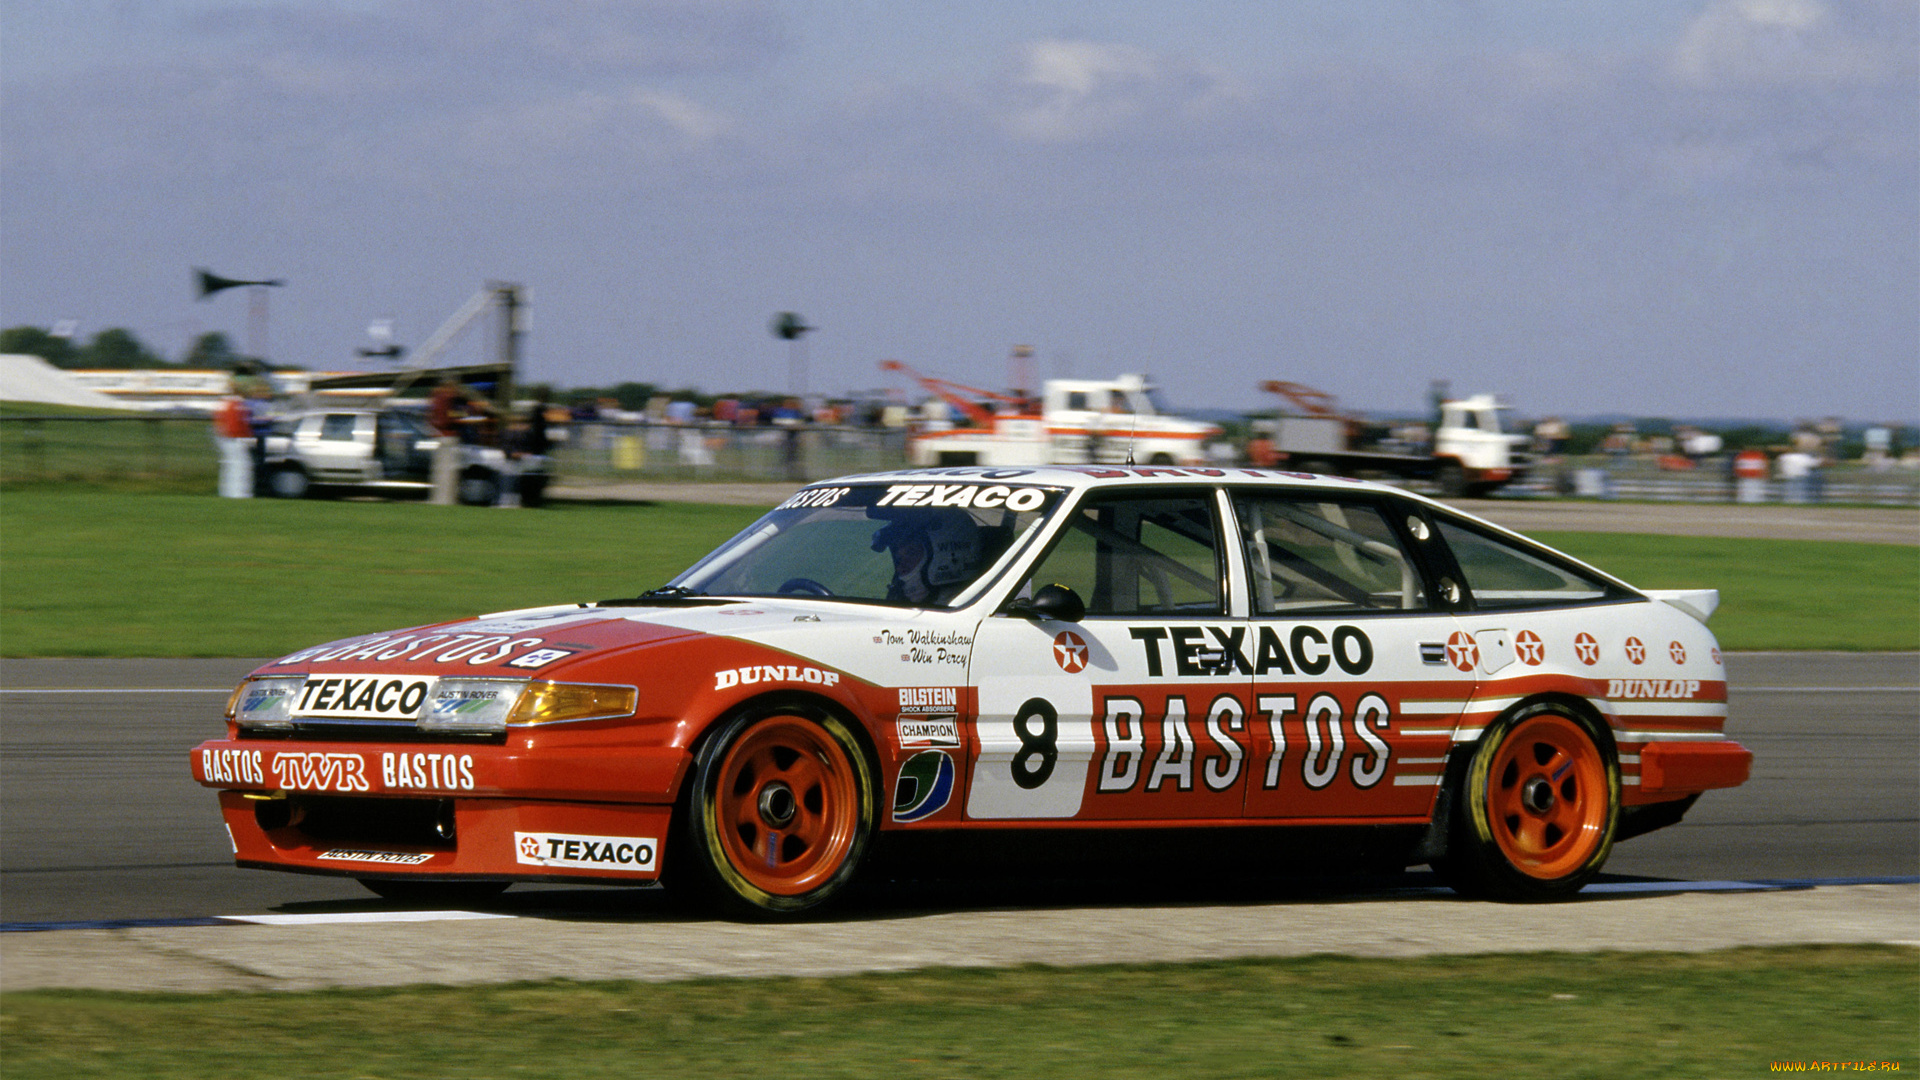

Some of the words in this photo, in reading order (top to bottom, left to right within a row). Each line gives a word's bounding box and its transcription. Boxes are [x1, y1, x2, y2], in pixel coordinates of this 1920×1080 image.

[876, 484, 1046, 512] TEXACO
[312, 633, 544, 665] BASTOS
[881, 629, 905, 645] Tom
[907, 629, 973, 645] Walkinshaw
[910, 647, 933, 663] Win
[937, 647, 967, 668] Percy
[1129, 625, 1374, 677] TEXACO
[714, 665, 840, 691] DUNLOP
[1606, 679, 1700, 698] DUNLOP
[298, 679, 428, 715] TEXACO
[438, 691, 467, 699] AUSTIN
[470, 691, 499, 699] ROVER
[898, 688, 957, 706] BILSTEIN
[902, 725, 954, 737] CHAMPION
[1012, 697, 1059, 789] 8
[1099, 691, 1394, 794] BASTOS
[202, 749, 264, 784] BASTOS
[271, 751, 370, 791] TWR
[382, 751, 475, 790] BASTOS
[547, 838, 653, 865] TEXACO
